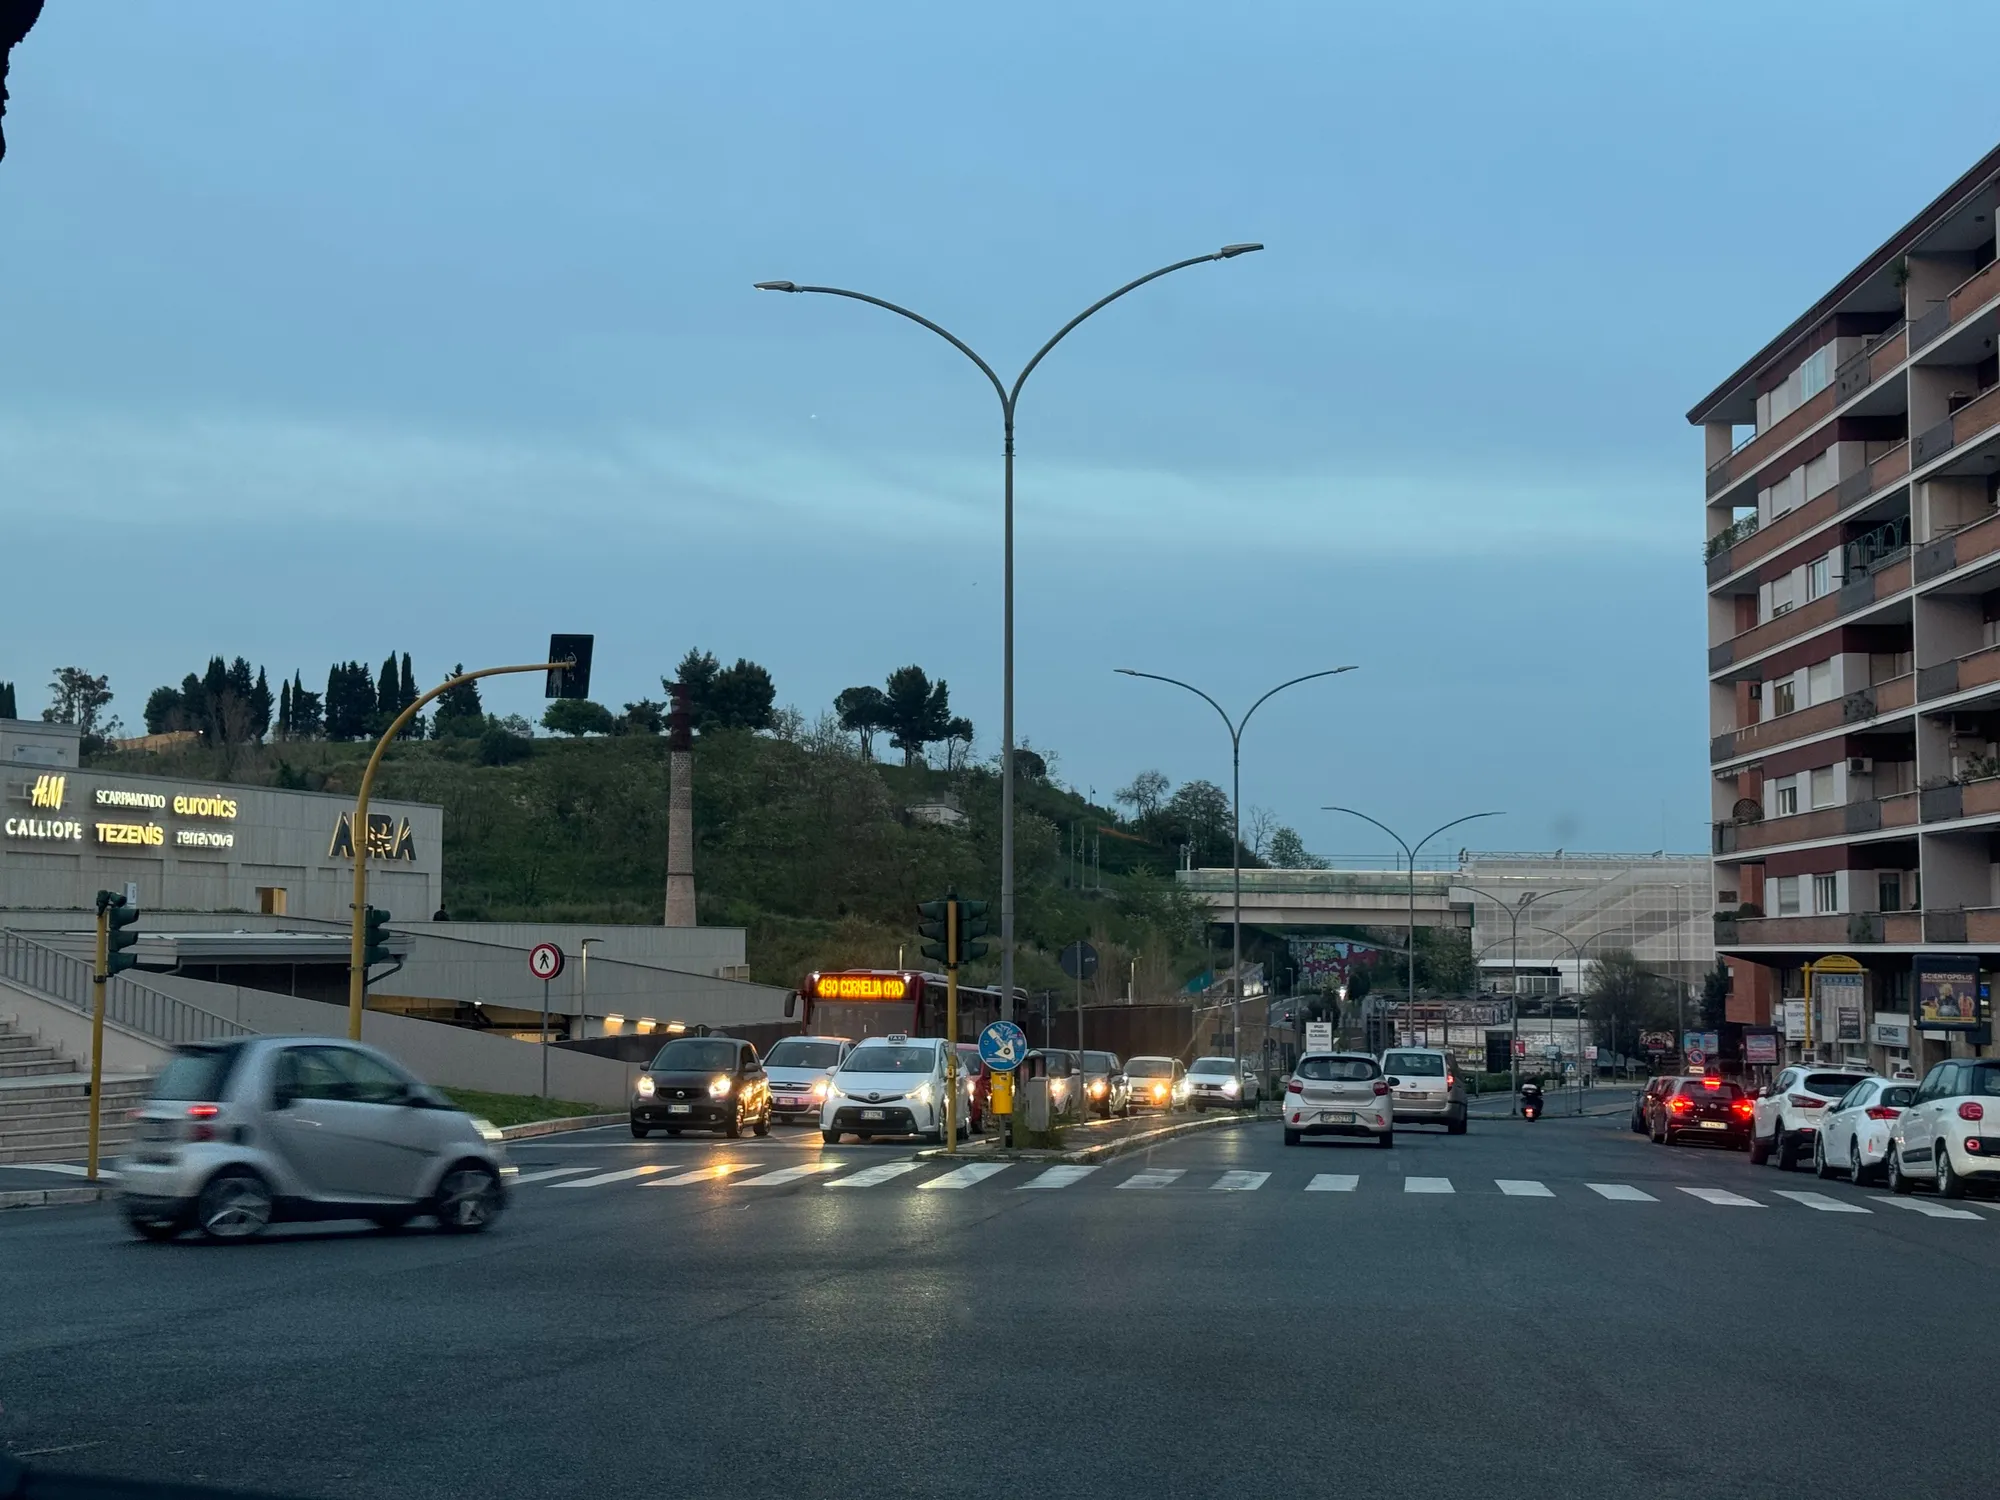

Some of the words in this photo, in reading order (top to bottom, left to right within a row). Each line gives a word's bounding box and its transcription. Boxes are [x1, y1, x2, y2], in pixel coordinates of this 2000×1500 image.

[31, 775, 66, 810] H&M
[173, 793, 237, 818] euronics
[5, 818, 82, 839] CALLIOPE
[818, 979, 838, 996] 490
[840, 979, 882, 996] CORNELIA
